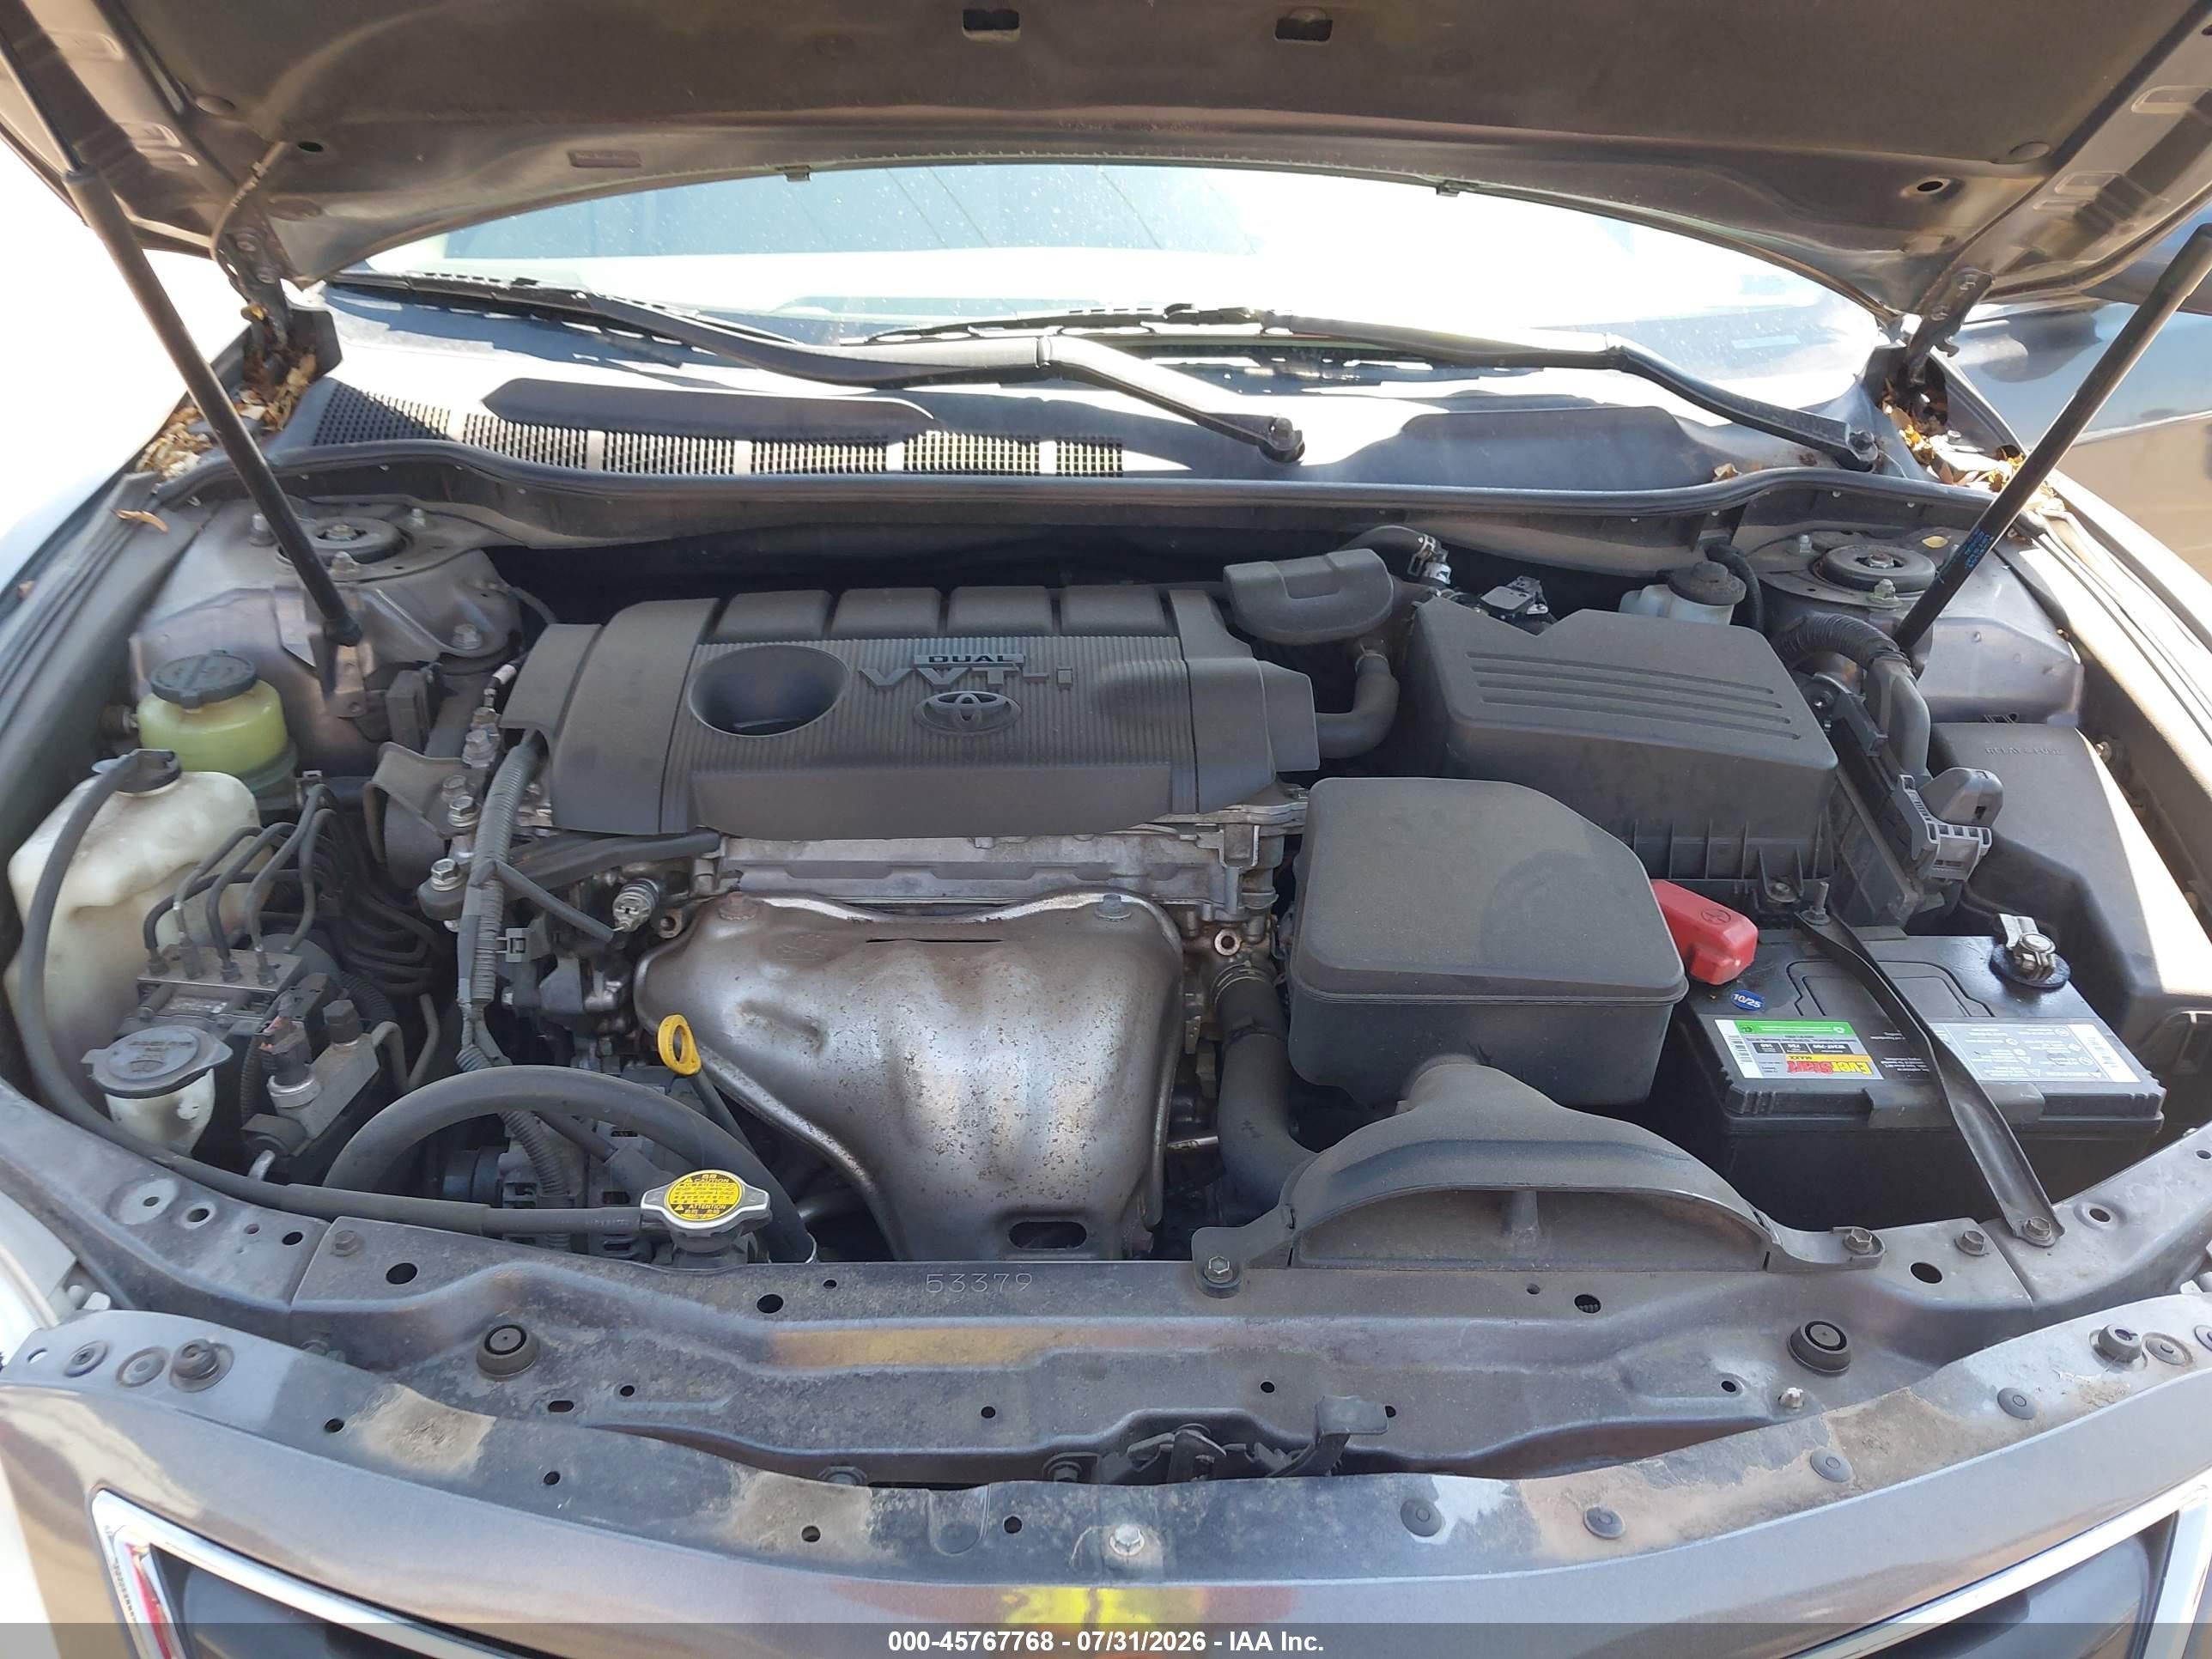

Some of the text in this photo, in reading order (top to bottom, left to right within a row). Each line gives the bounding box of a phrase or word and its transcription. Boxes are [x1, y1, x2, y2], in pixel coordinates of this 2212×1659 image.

[927, 654, 1014, 664] DUAL
[859, 665, 1073, 687] VVT-i
[1733, 994, 1763, 1008] 10/25
[1787, 1060, 1872, 1074] EverStart
[926, 1273, 1032, 1293] 53379
